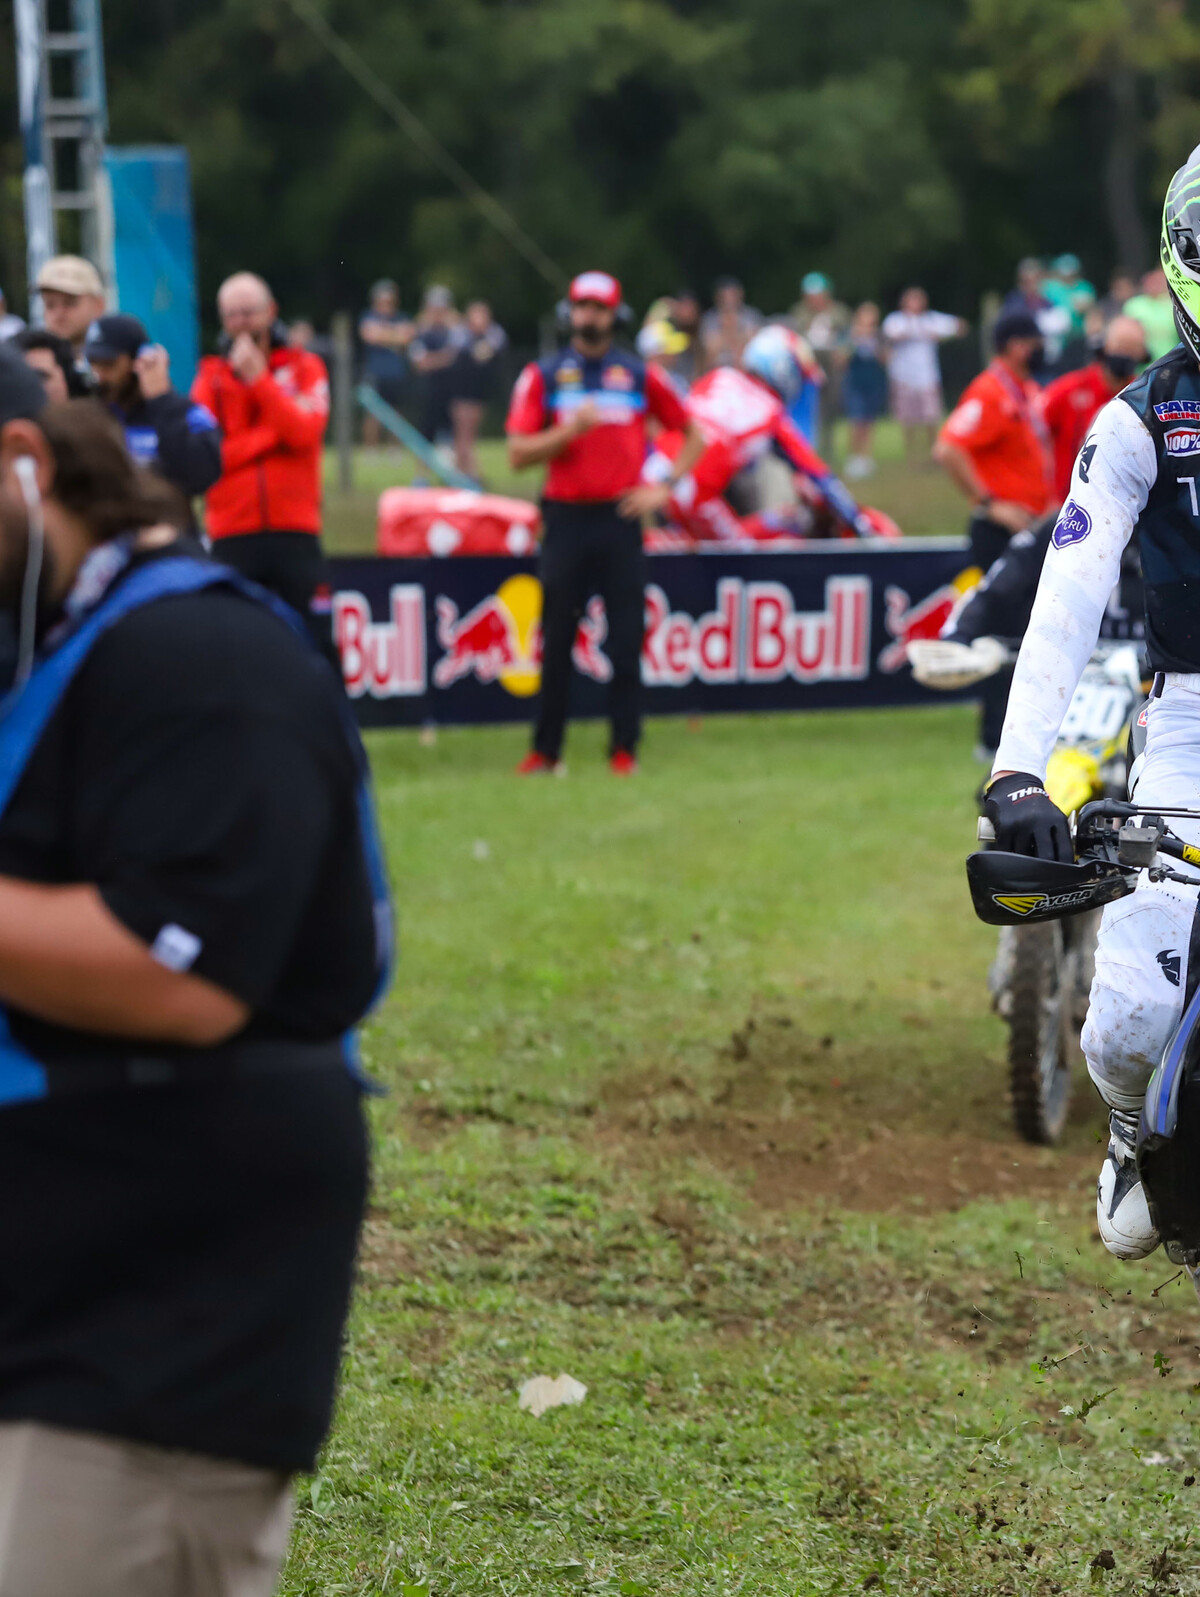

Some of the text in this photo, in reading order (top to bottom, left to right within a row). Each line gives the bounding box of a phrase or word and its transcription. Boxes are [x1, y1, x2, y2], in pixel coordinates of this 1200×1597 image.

[331, 584, 426, 699] Bull
[744, 574, 872, 684] Bull
[1035, 889, 1093, 910] CYCRA
